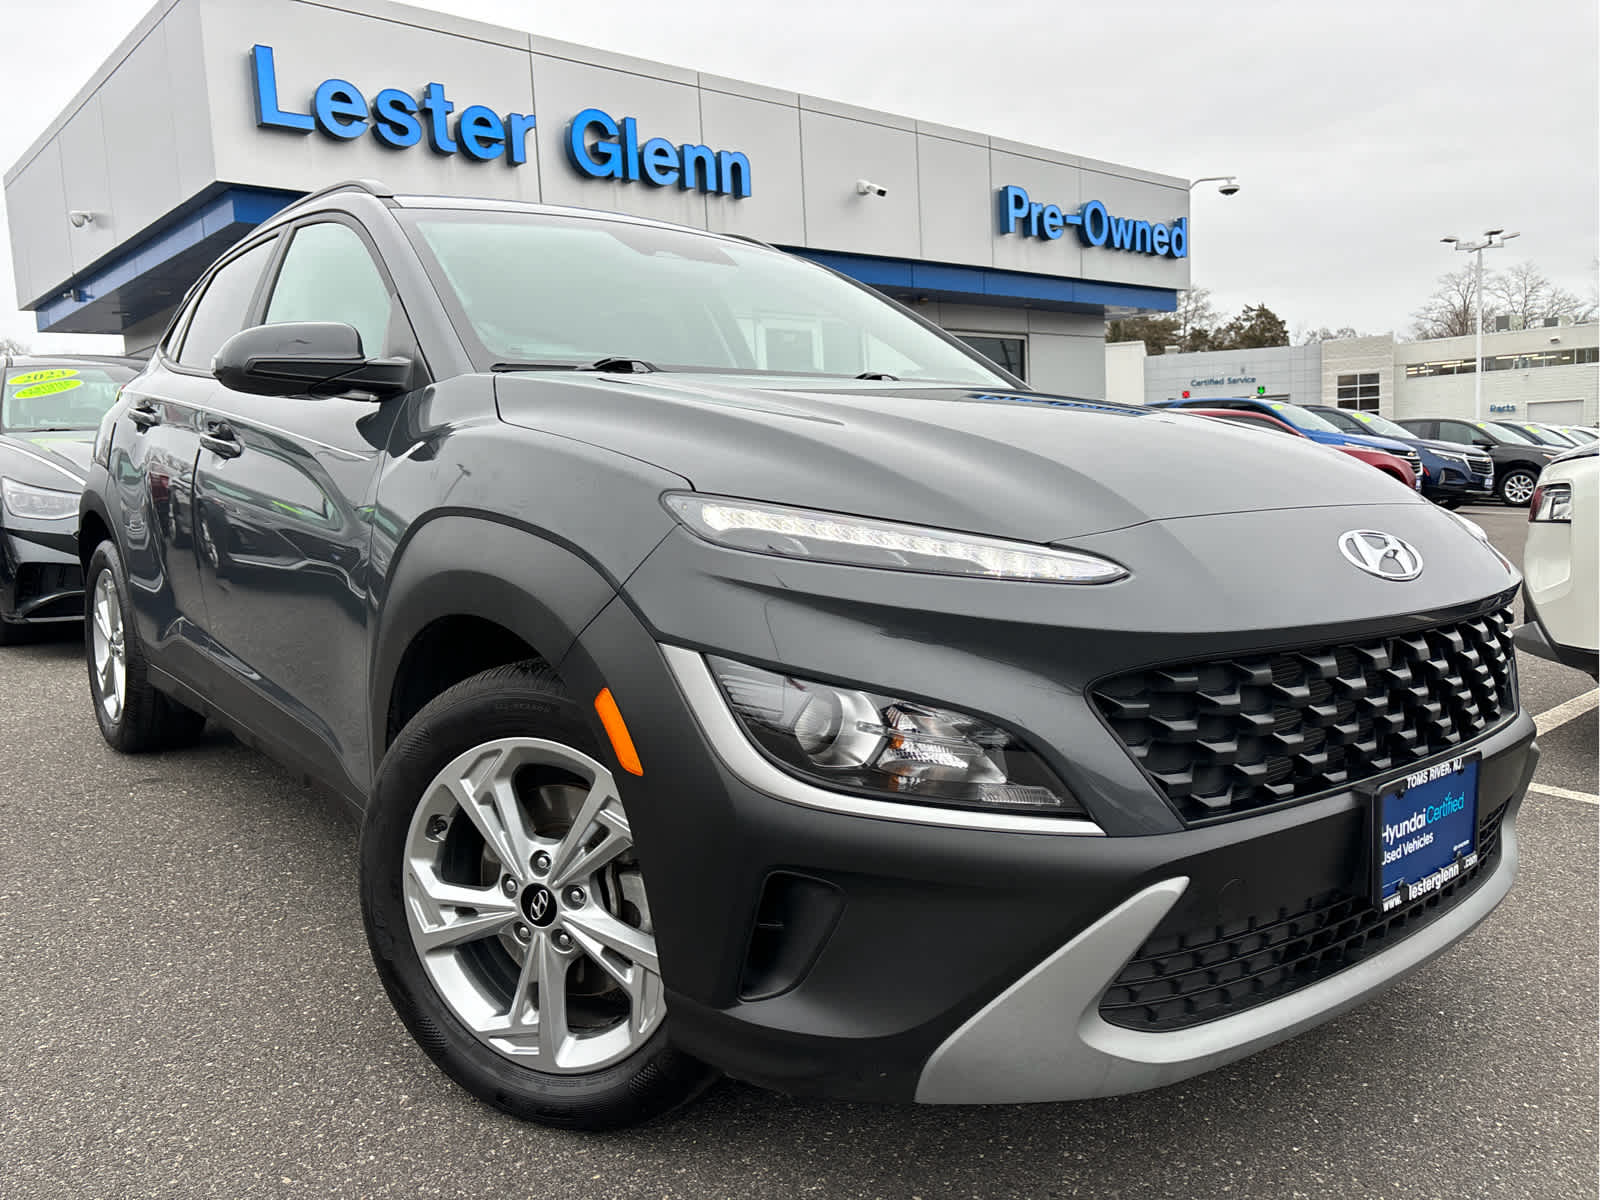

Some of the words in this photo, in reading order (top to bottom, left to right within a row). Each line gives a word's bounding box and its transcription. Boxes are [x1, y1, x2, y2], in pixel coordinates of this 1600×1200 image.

[249, 44, 537, 167] Lester
[566, 108, 753, 199] Glenn
[999, 184, 1188, 259] Pre-Owned
[1190, 376, 1225, 388] Certified
[1227, 375, 1257, 386] Service
[1406, 770, 1429, 789] TOMS
[1402, 832, 1434, 855] Vehicles
[1408, 863, 1459, 901] lesterglenn
